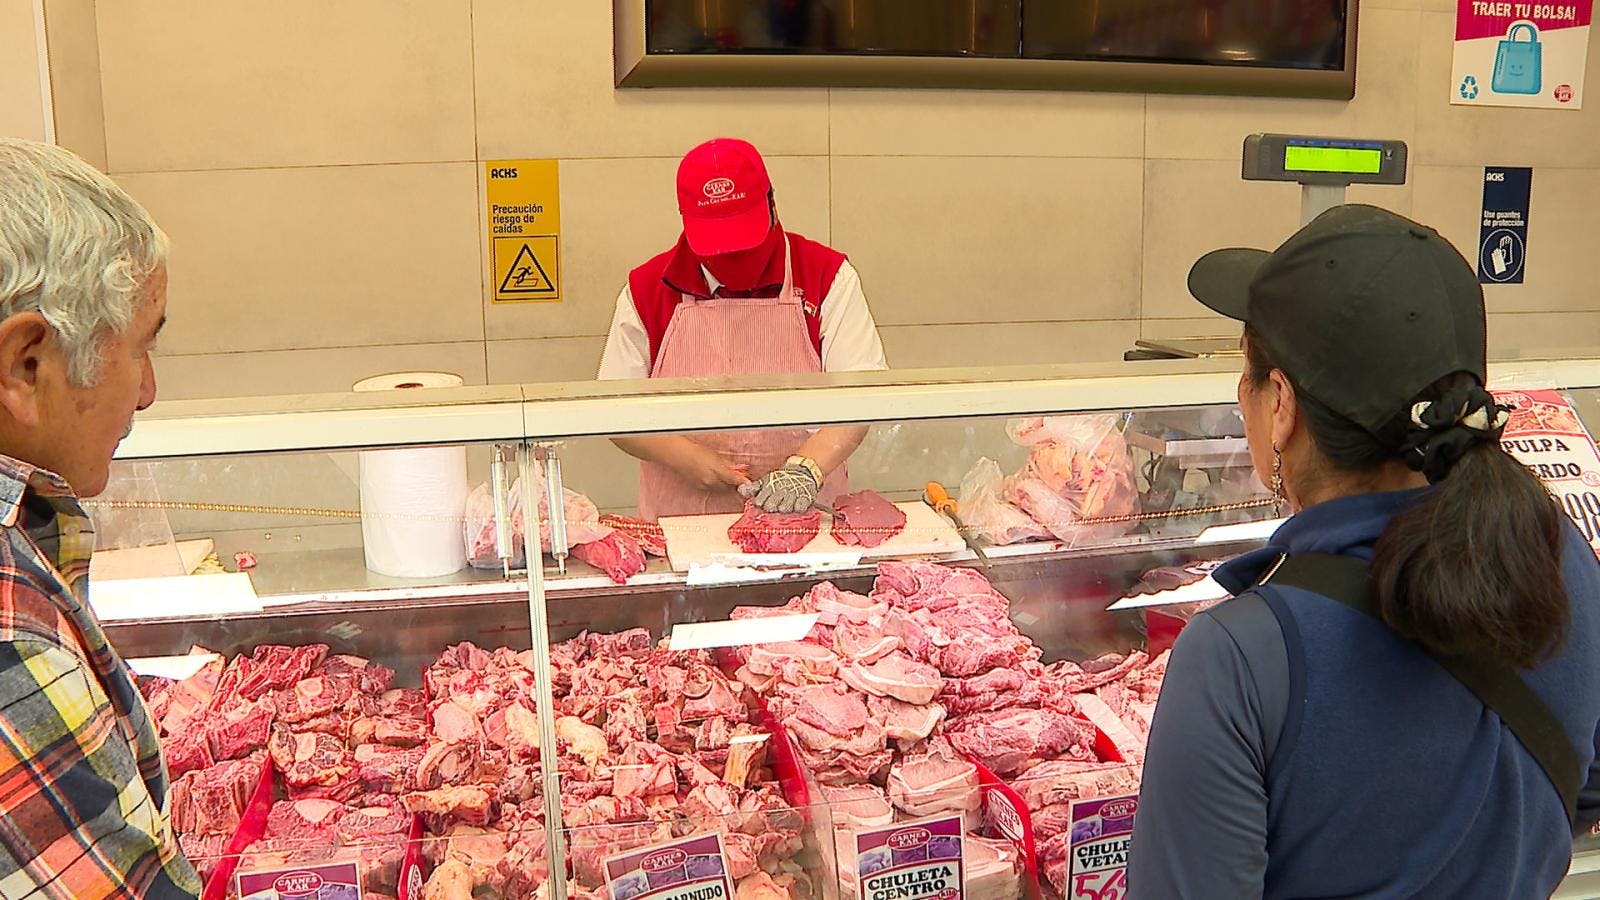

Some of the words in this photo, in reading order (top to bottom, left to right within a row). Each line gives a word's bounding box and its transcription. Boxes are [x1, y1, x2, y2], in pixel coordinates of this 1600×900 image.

[1472, 1, 1511, 17] TRAER
[1514, 4, 1531, 18] TU
[1533, 5, 1576, 20] BOLSA!
[491, 168, 517, 178] ACHS
[492, 203, 542, 214] Precaución
[493, 215, 521, 225] riesgo
[523, 215, 534, 223] de
[1501, 438, 1570, 453] PULPA
[1102, 803, 1135, 813] CARNES
[890, 831, 926, 842] CARNES
[899, 838, 918, 848] KAR
[643, 852, 682, 865] CARNES
[278, 875, 318, 886] CARNES
[868, 866, 952, 890] CHULETA
[287, 883, 309, 892] KAR
[873, 879, 946, 900] CENTRO
